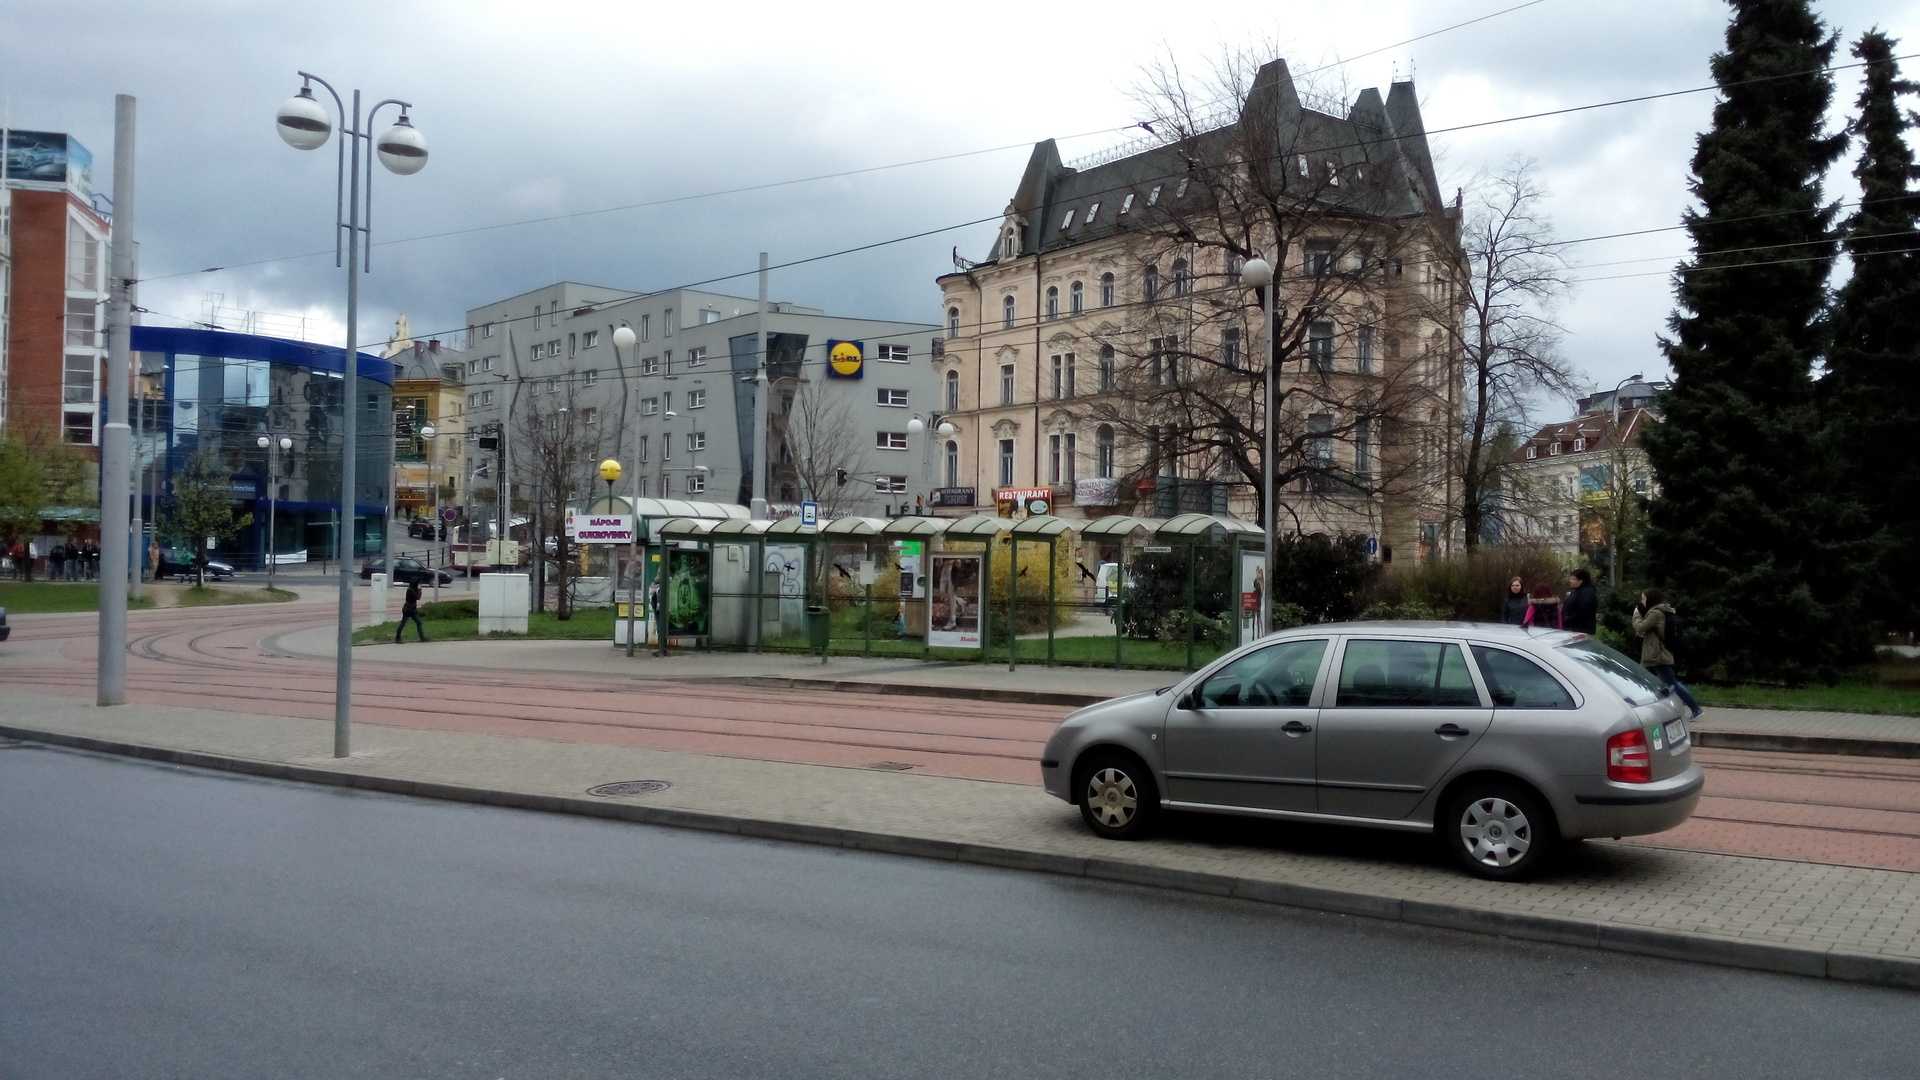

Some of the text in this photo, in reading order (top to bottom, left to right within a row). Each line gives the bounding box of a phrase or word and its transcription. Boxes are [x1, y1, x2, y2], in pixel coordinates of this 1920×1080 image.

[999, 489, 1049, 500] RESTAURANT
[589, 518, 622, 526] NÁPOJE
[578, 531, 632, 539] CUKROVINKY
